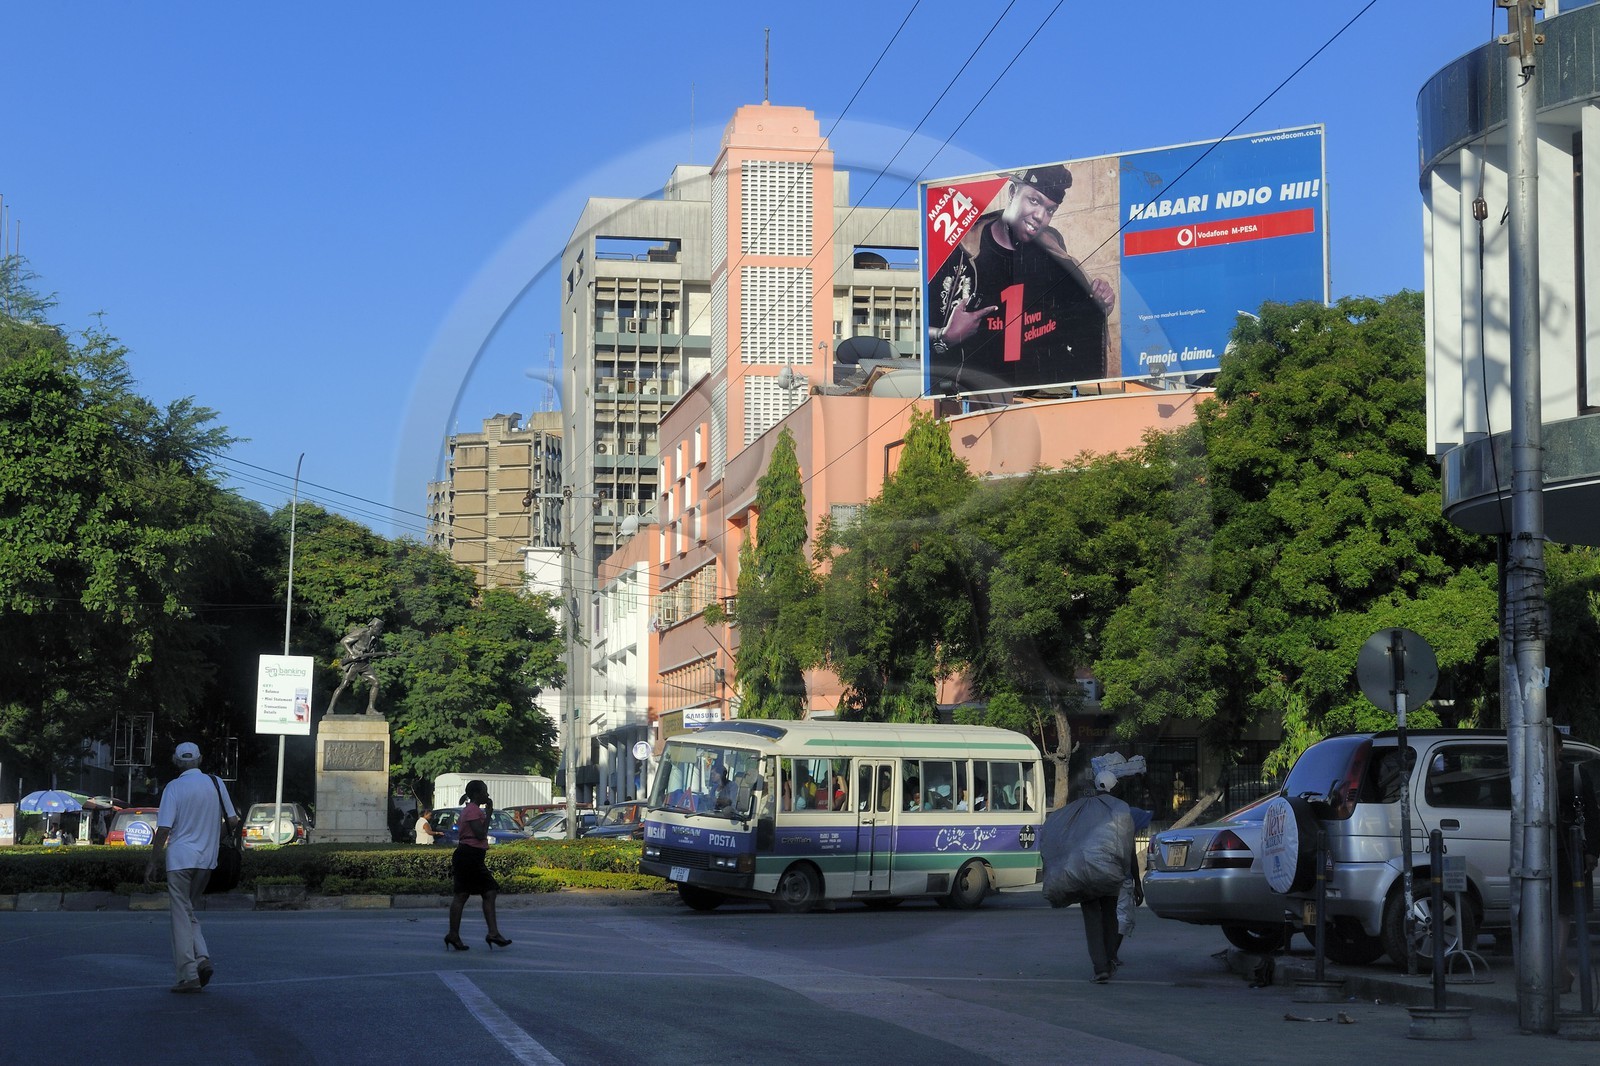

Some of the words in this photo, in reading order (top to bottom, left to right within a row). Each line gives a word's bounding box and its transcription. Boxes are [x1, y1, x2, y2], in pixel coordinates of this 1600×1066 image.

[928, 187, 957, 221] MASAA
[1128, 194, 1209, 221] HABARI
[1215, 186, 1272, 210] NDIO
[1279, 178, 1321, 202] HII!
[933, 191, 974, 242] 24
[946, 227, 965, 247] KILA
[961, 206, 979, 228] SIKU
[1197, 229, 1229, 239] Vodafone
[1231, 224, 1258, 235] M-PESA
[986, 316, 1004, 331] Tsh
[1000, 283, 1025, 362] 1
[1024, 311, 1042, 326] kwa
[1023, 319, 1057, 342] sekunde
[1139, 349, 1178, 367] Pamoja
[1180, 346, 1216, 362] daima.
[685, 712, 719, 720] SAMSUNG
[126, 827, 152, 835] OXFORD
[671, 825, 702, 837] NISSAN
[708, 832, 736, 848] POSTA
